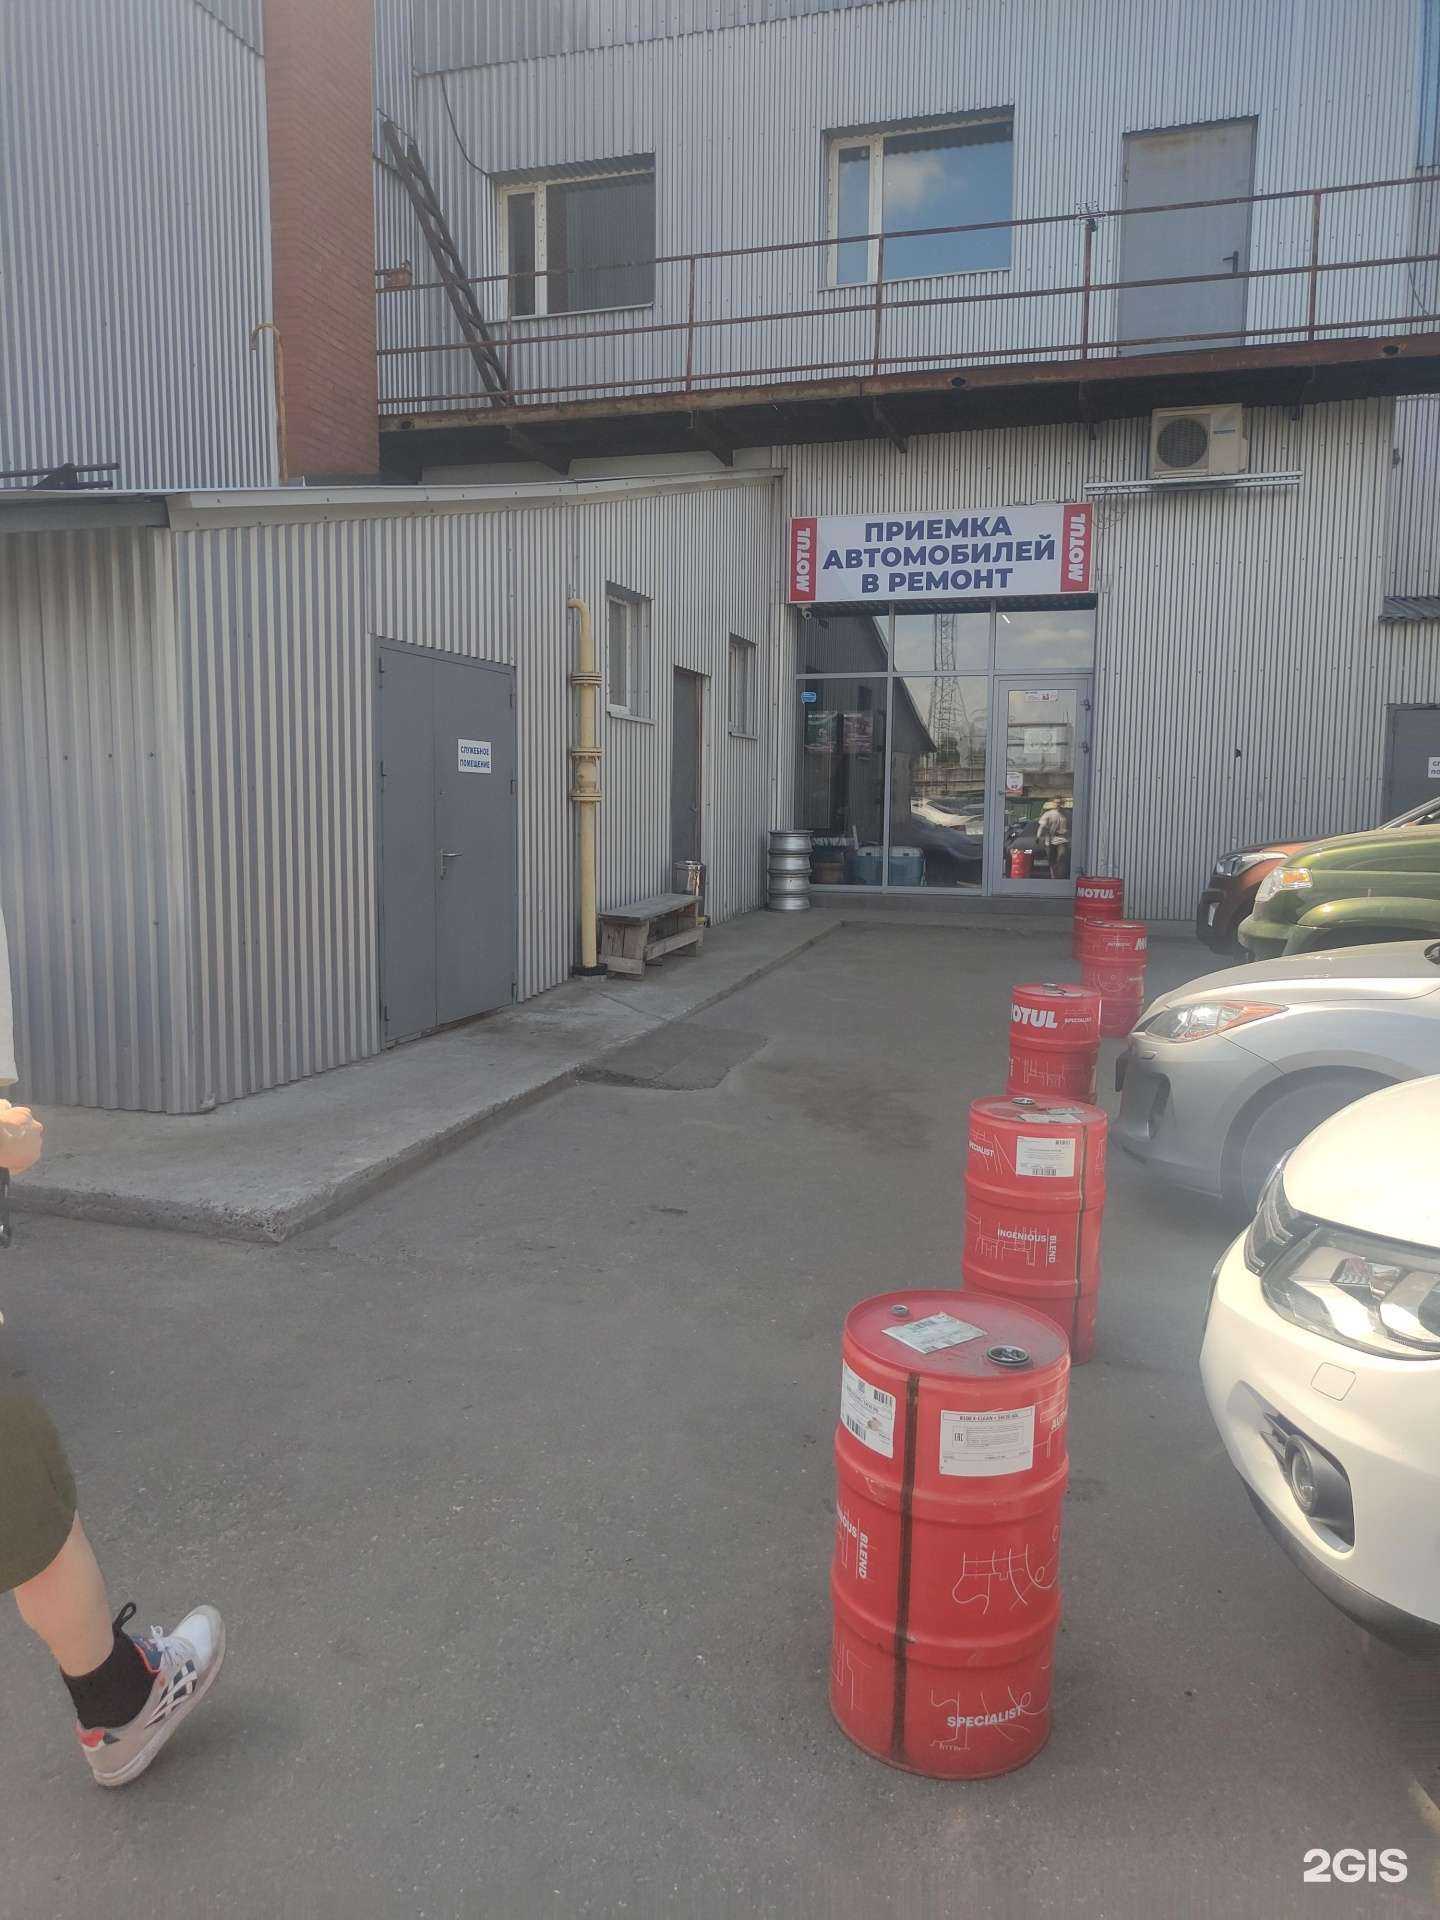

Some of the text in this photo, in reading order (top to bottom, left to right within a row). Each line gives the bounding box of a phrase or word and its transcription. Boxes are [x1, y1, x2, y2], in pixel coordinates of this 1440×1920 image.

[864, 515, 1013, 543] ПРИЕМКА
[796, 527, 811, 593] MOTUL
[822, 534, 1055, 570] АВТОМОБИЛЕЙ
[1068, 513, 1086, 582] MOTUL
[861, 568, 1014, 594] В РЕМОНТ
[1077, 887, 1114, 899] MOTUL
[997, 1228, 1047, 1242] INGENIOUS
[1048, 1235, 1057, 1263] BLEND
[859, 1532, 869, 1579] BLEND
[947, 1705, 1022, 1728] SPECIALIST
